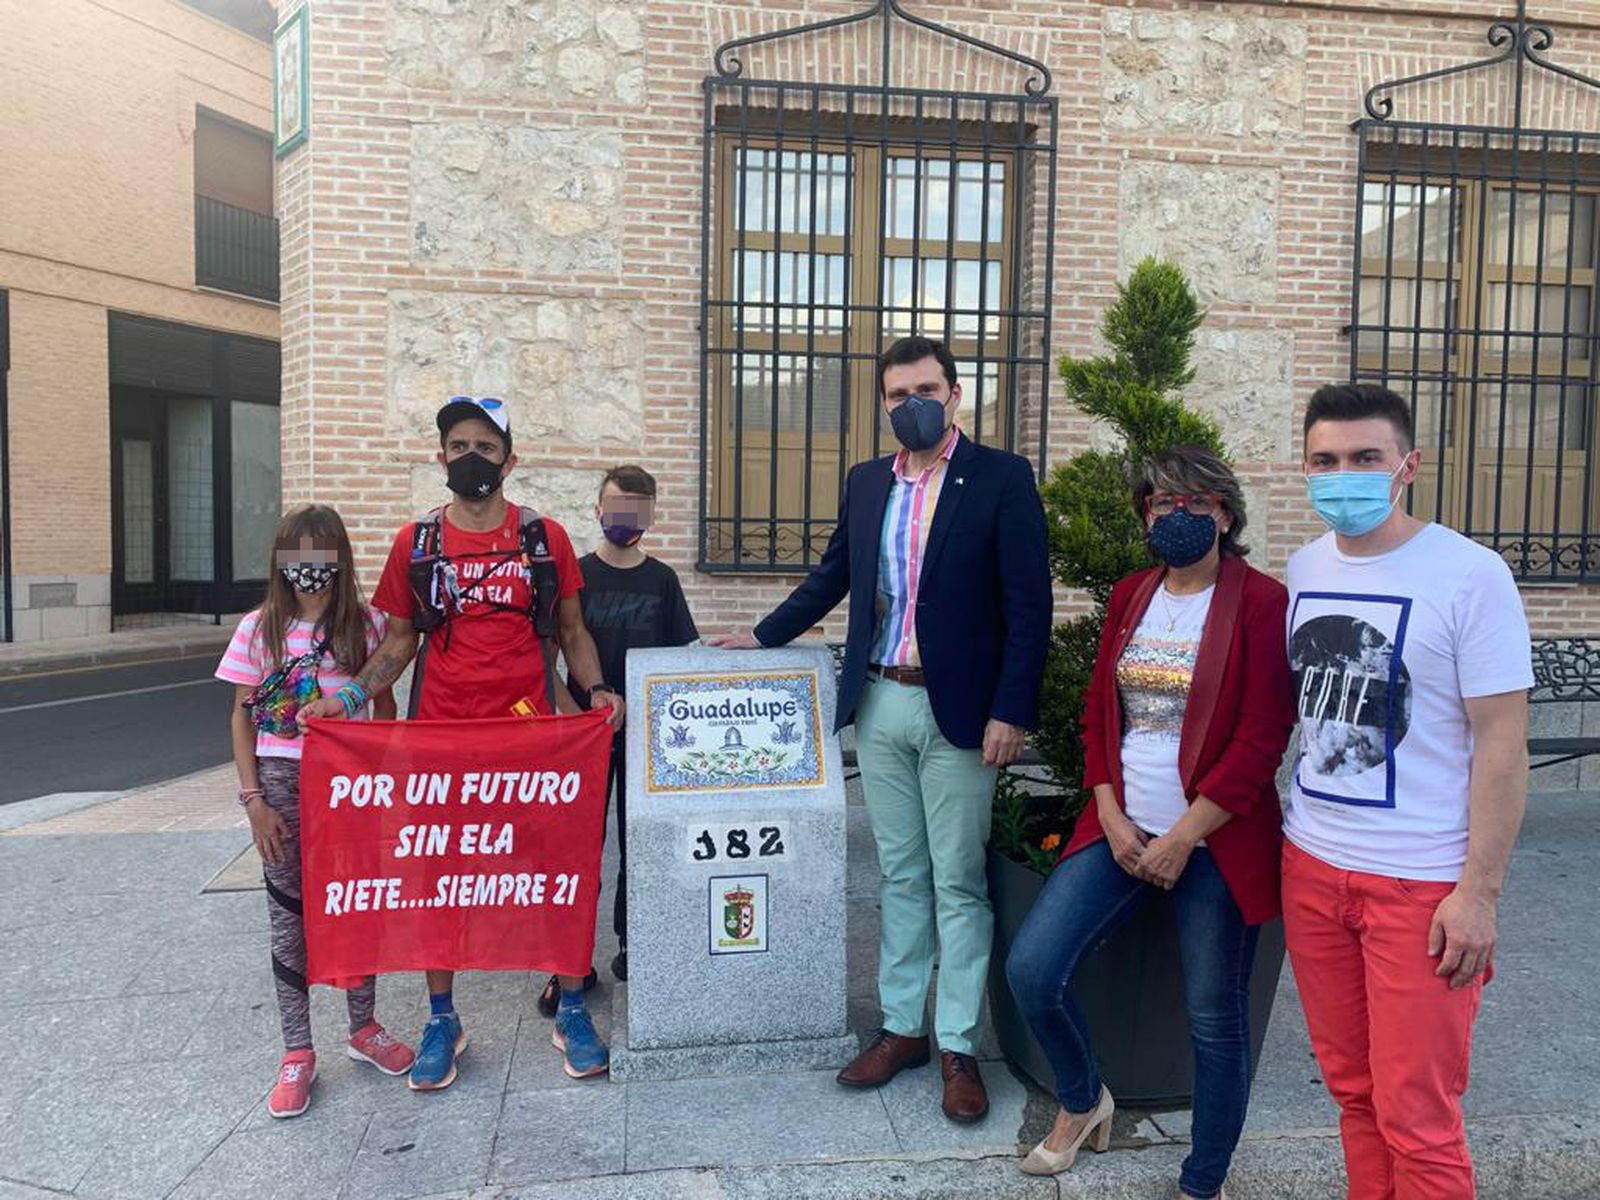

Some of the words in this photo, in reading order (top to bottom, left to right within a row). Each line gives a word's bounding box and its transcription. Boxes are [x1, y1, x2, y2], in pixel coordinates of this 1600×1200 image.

[487, 586, 512, 603] ELA
[329, 774, 394, 808] POR
[405, 774, 451, 805] UN
[460, 771, 580, 805] FUTURO
[395, 824, 450, 858] SIN
[460, 822, 513, 855] ELA
[693, 827, 784, 860] 182
[552, 874, 579, 906] 21
